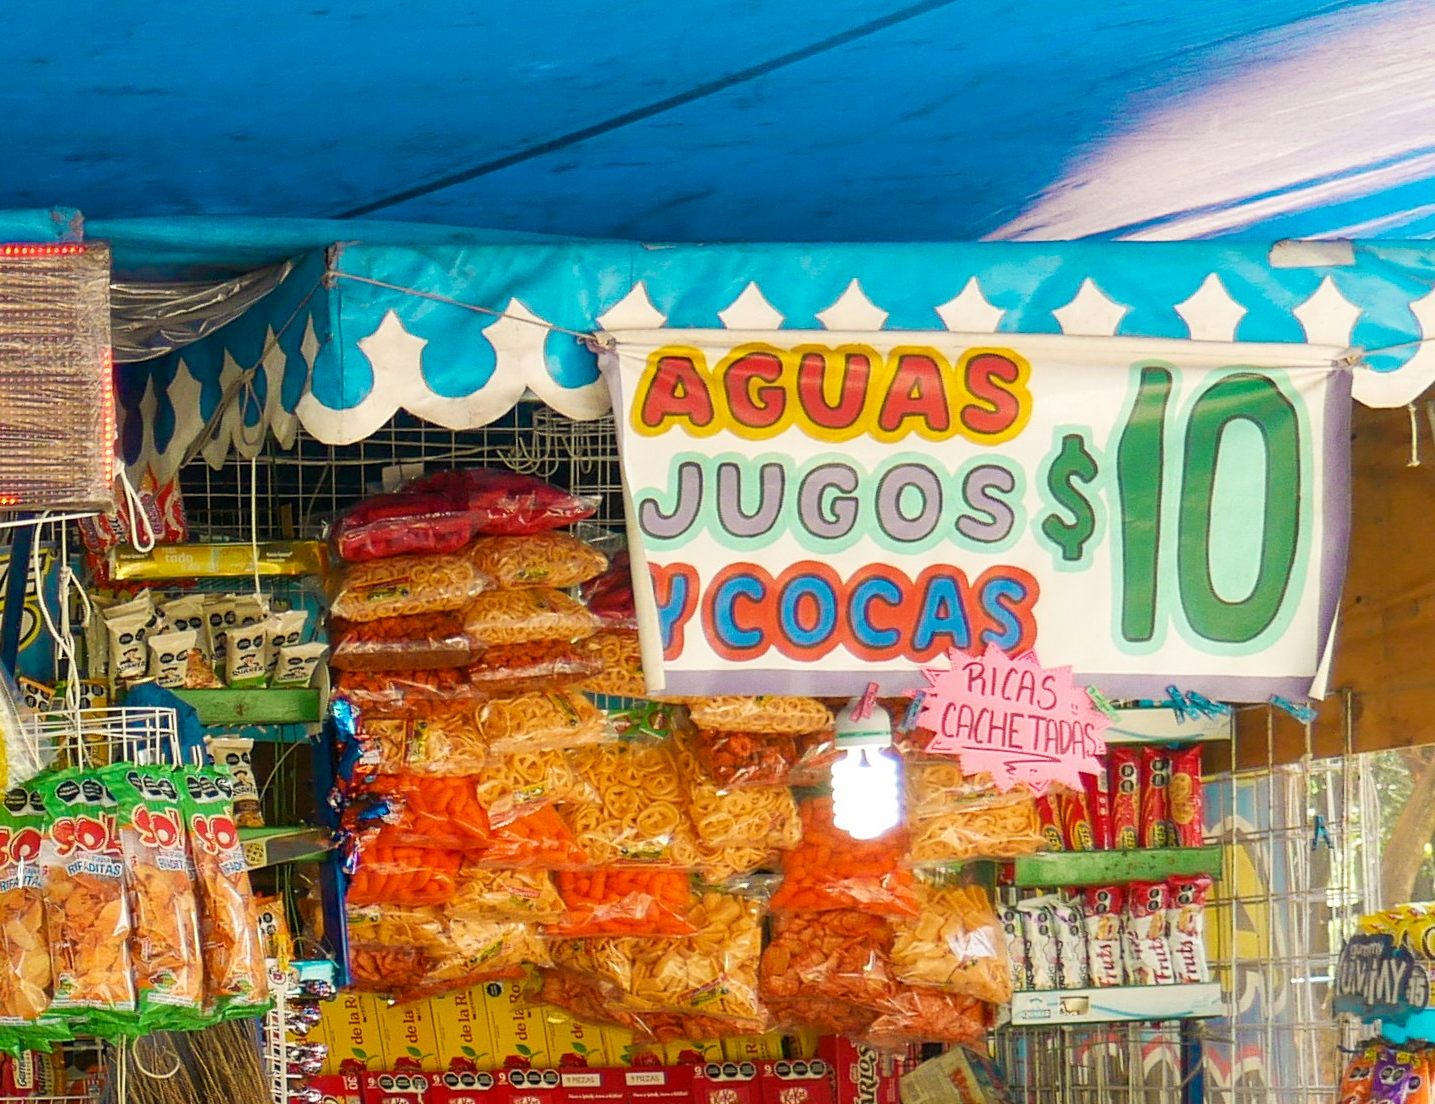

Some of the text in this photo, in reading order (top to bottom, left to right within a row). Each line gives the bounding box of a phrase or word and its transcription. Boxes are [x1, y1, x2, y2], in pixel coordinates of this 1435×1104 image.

[640, 351, 1023, 436] AGUAS
[637, 461, 1019, 544] JUGOS
[710, 574, 1029, 652] COCAS
[963, 661, 1058, 709] RICAS
[940, 703, 1100, 756] CACHETADAS
[49, 814, 123, 856] SOL
[67, 861, 122, 877] RIFADITAS
